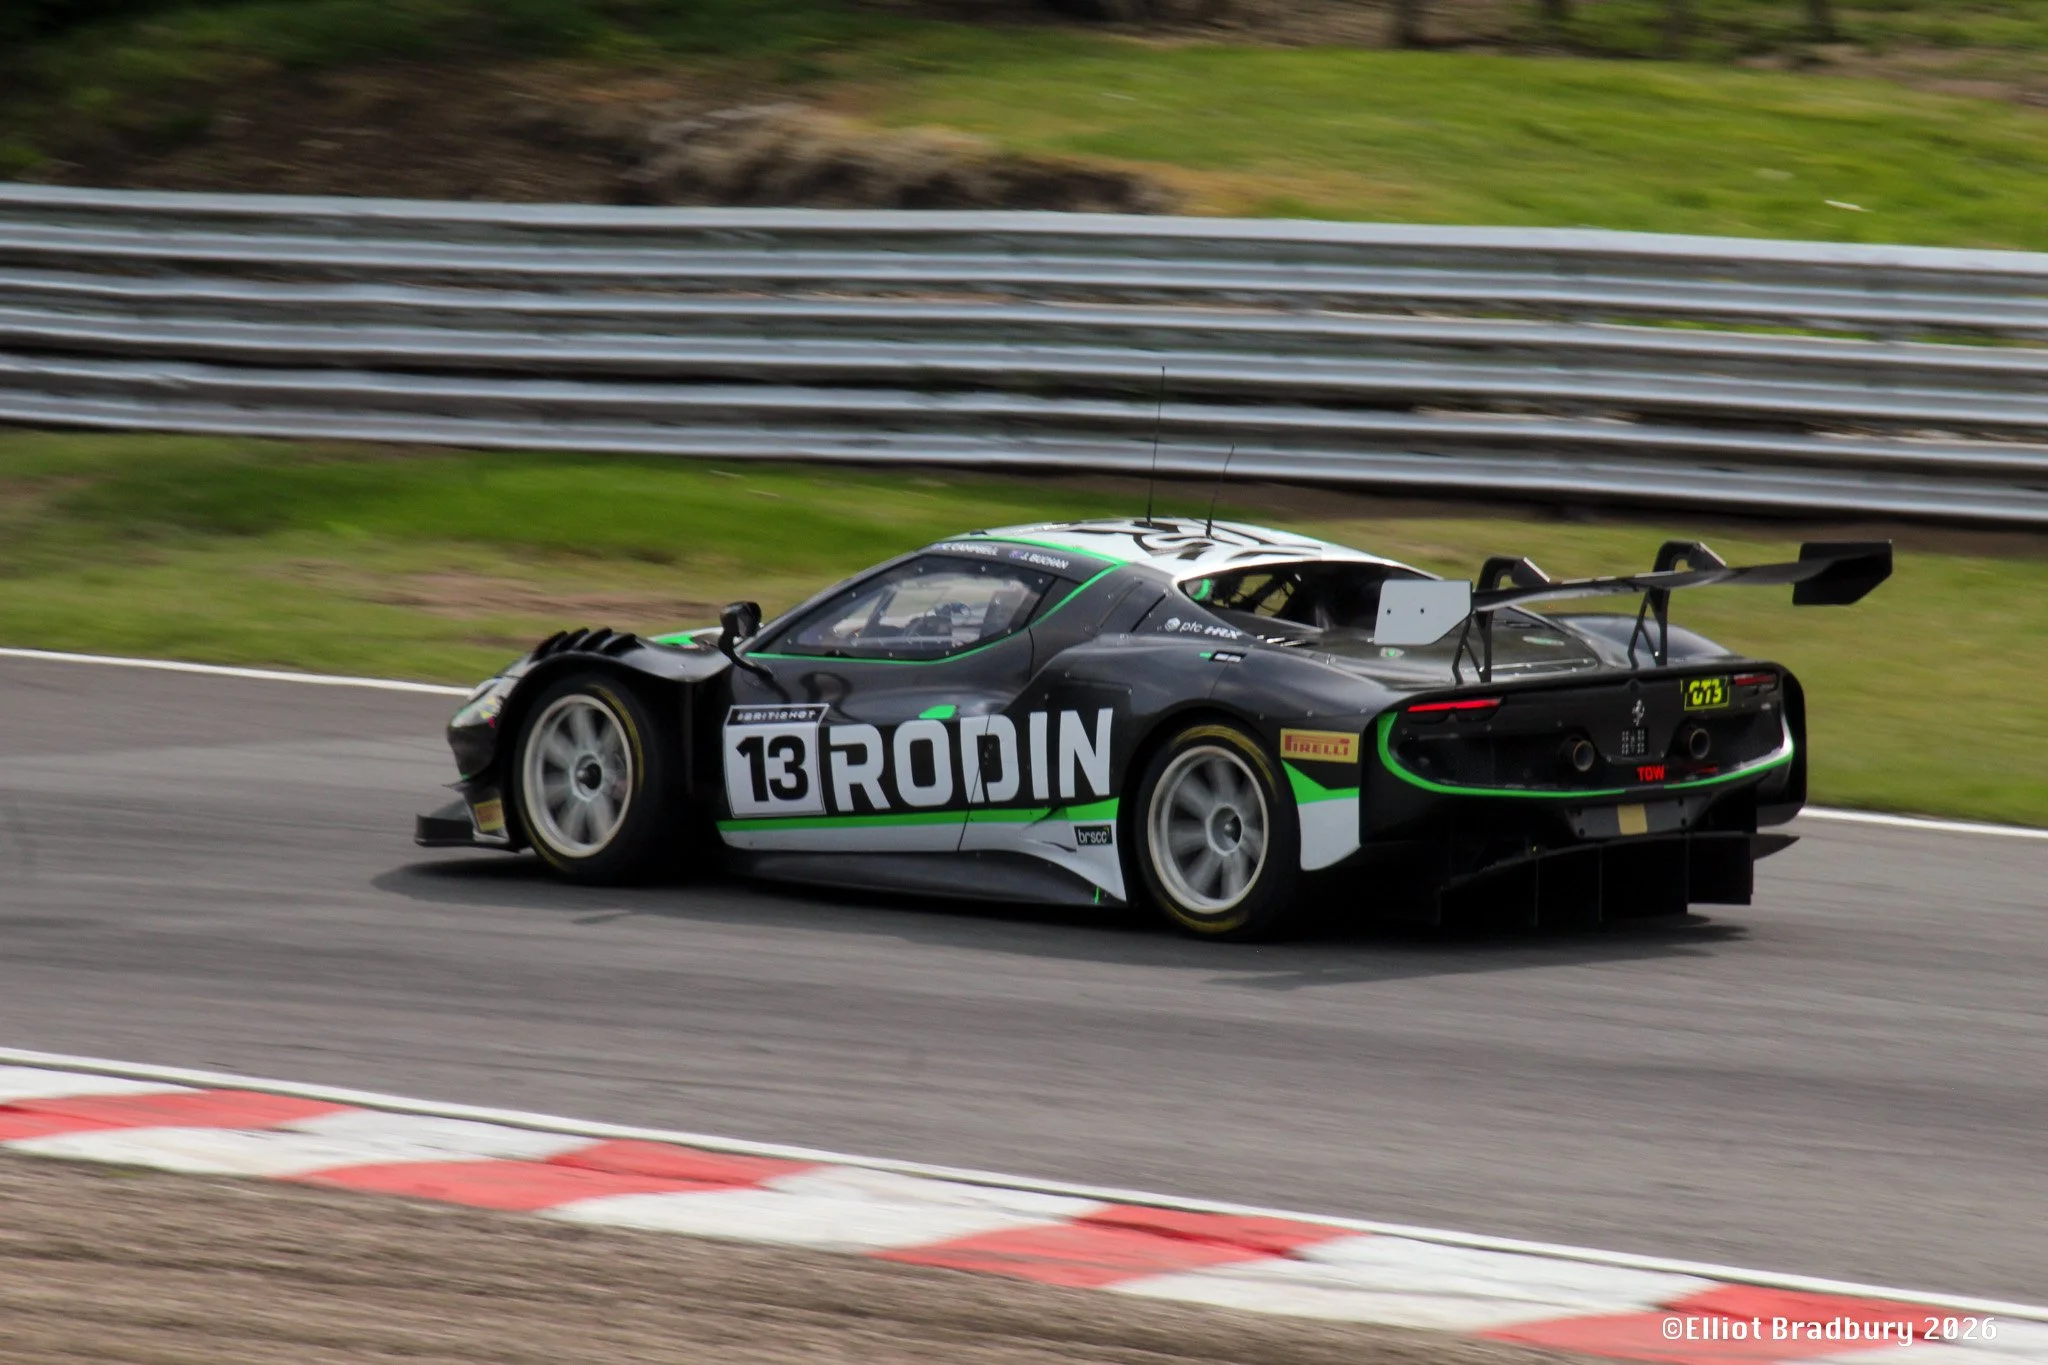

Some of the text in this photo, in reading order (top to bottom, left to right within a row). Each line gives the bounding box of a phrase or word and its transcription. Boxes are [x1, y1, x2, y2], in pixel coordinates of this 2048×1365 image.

[1689, 678, 1722, 705] GT3
[1284, 734, 1351, 756] PIRELLI
[735, 735, 809, 803] 13
[828, 707, 1114, 812] RODIN
[1636, 765, 1666, 781] TOW
[1077, 828, 1108, 844] brscc
